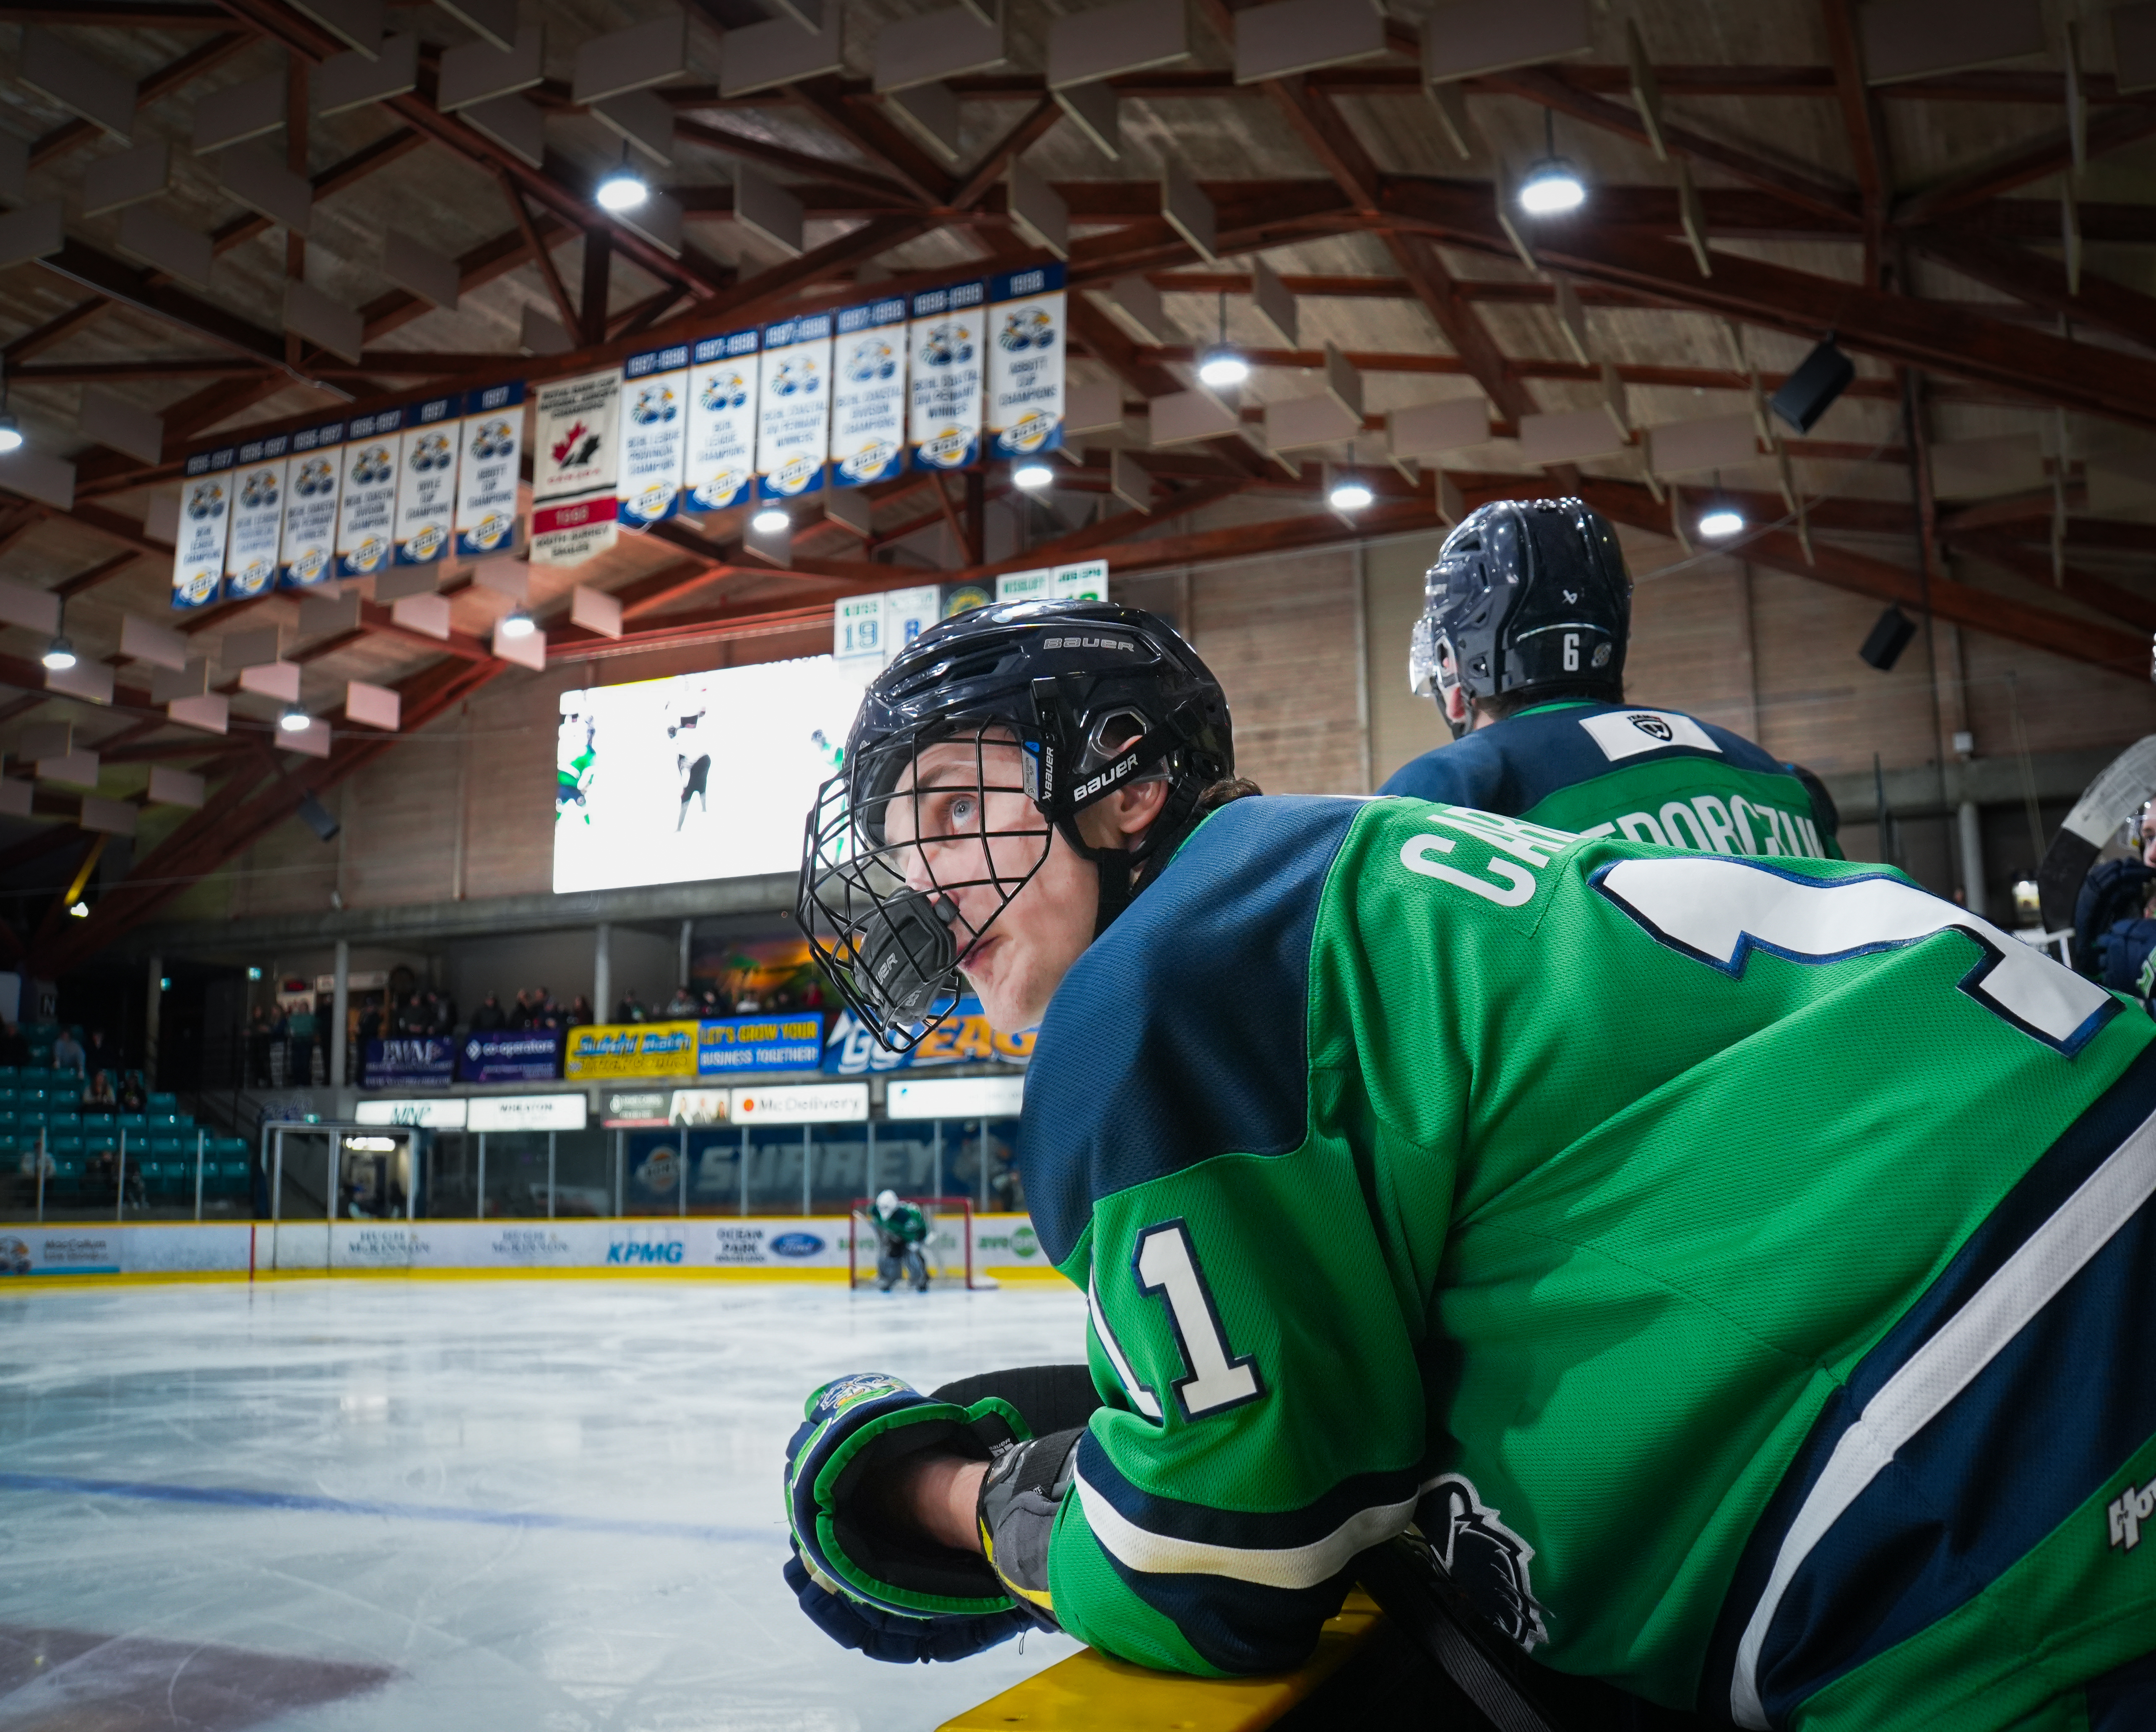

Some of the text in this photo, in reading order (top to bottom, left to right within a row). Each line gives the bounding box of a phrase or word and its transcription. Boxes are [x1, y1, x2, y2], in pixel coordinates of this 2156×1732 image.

[845, 620, 878, 651] 19
[1044, 637, 1134, 652] BAUER
[1563, 633, 1580, 671] 6
[1045, 747, 1054, 791] BAUER
[1073, 754, 1138, 802] BAUER
[739, 1023, 777, 1043] GROW
[779, 1021, 817, 1039] YOUR
[700, 1049, 753, 1066] BUSINESS
[696, 1139, 945, 1192] SURREY
[606, 1241, 684, 1264] KPMG
